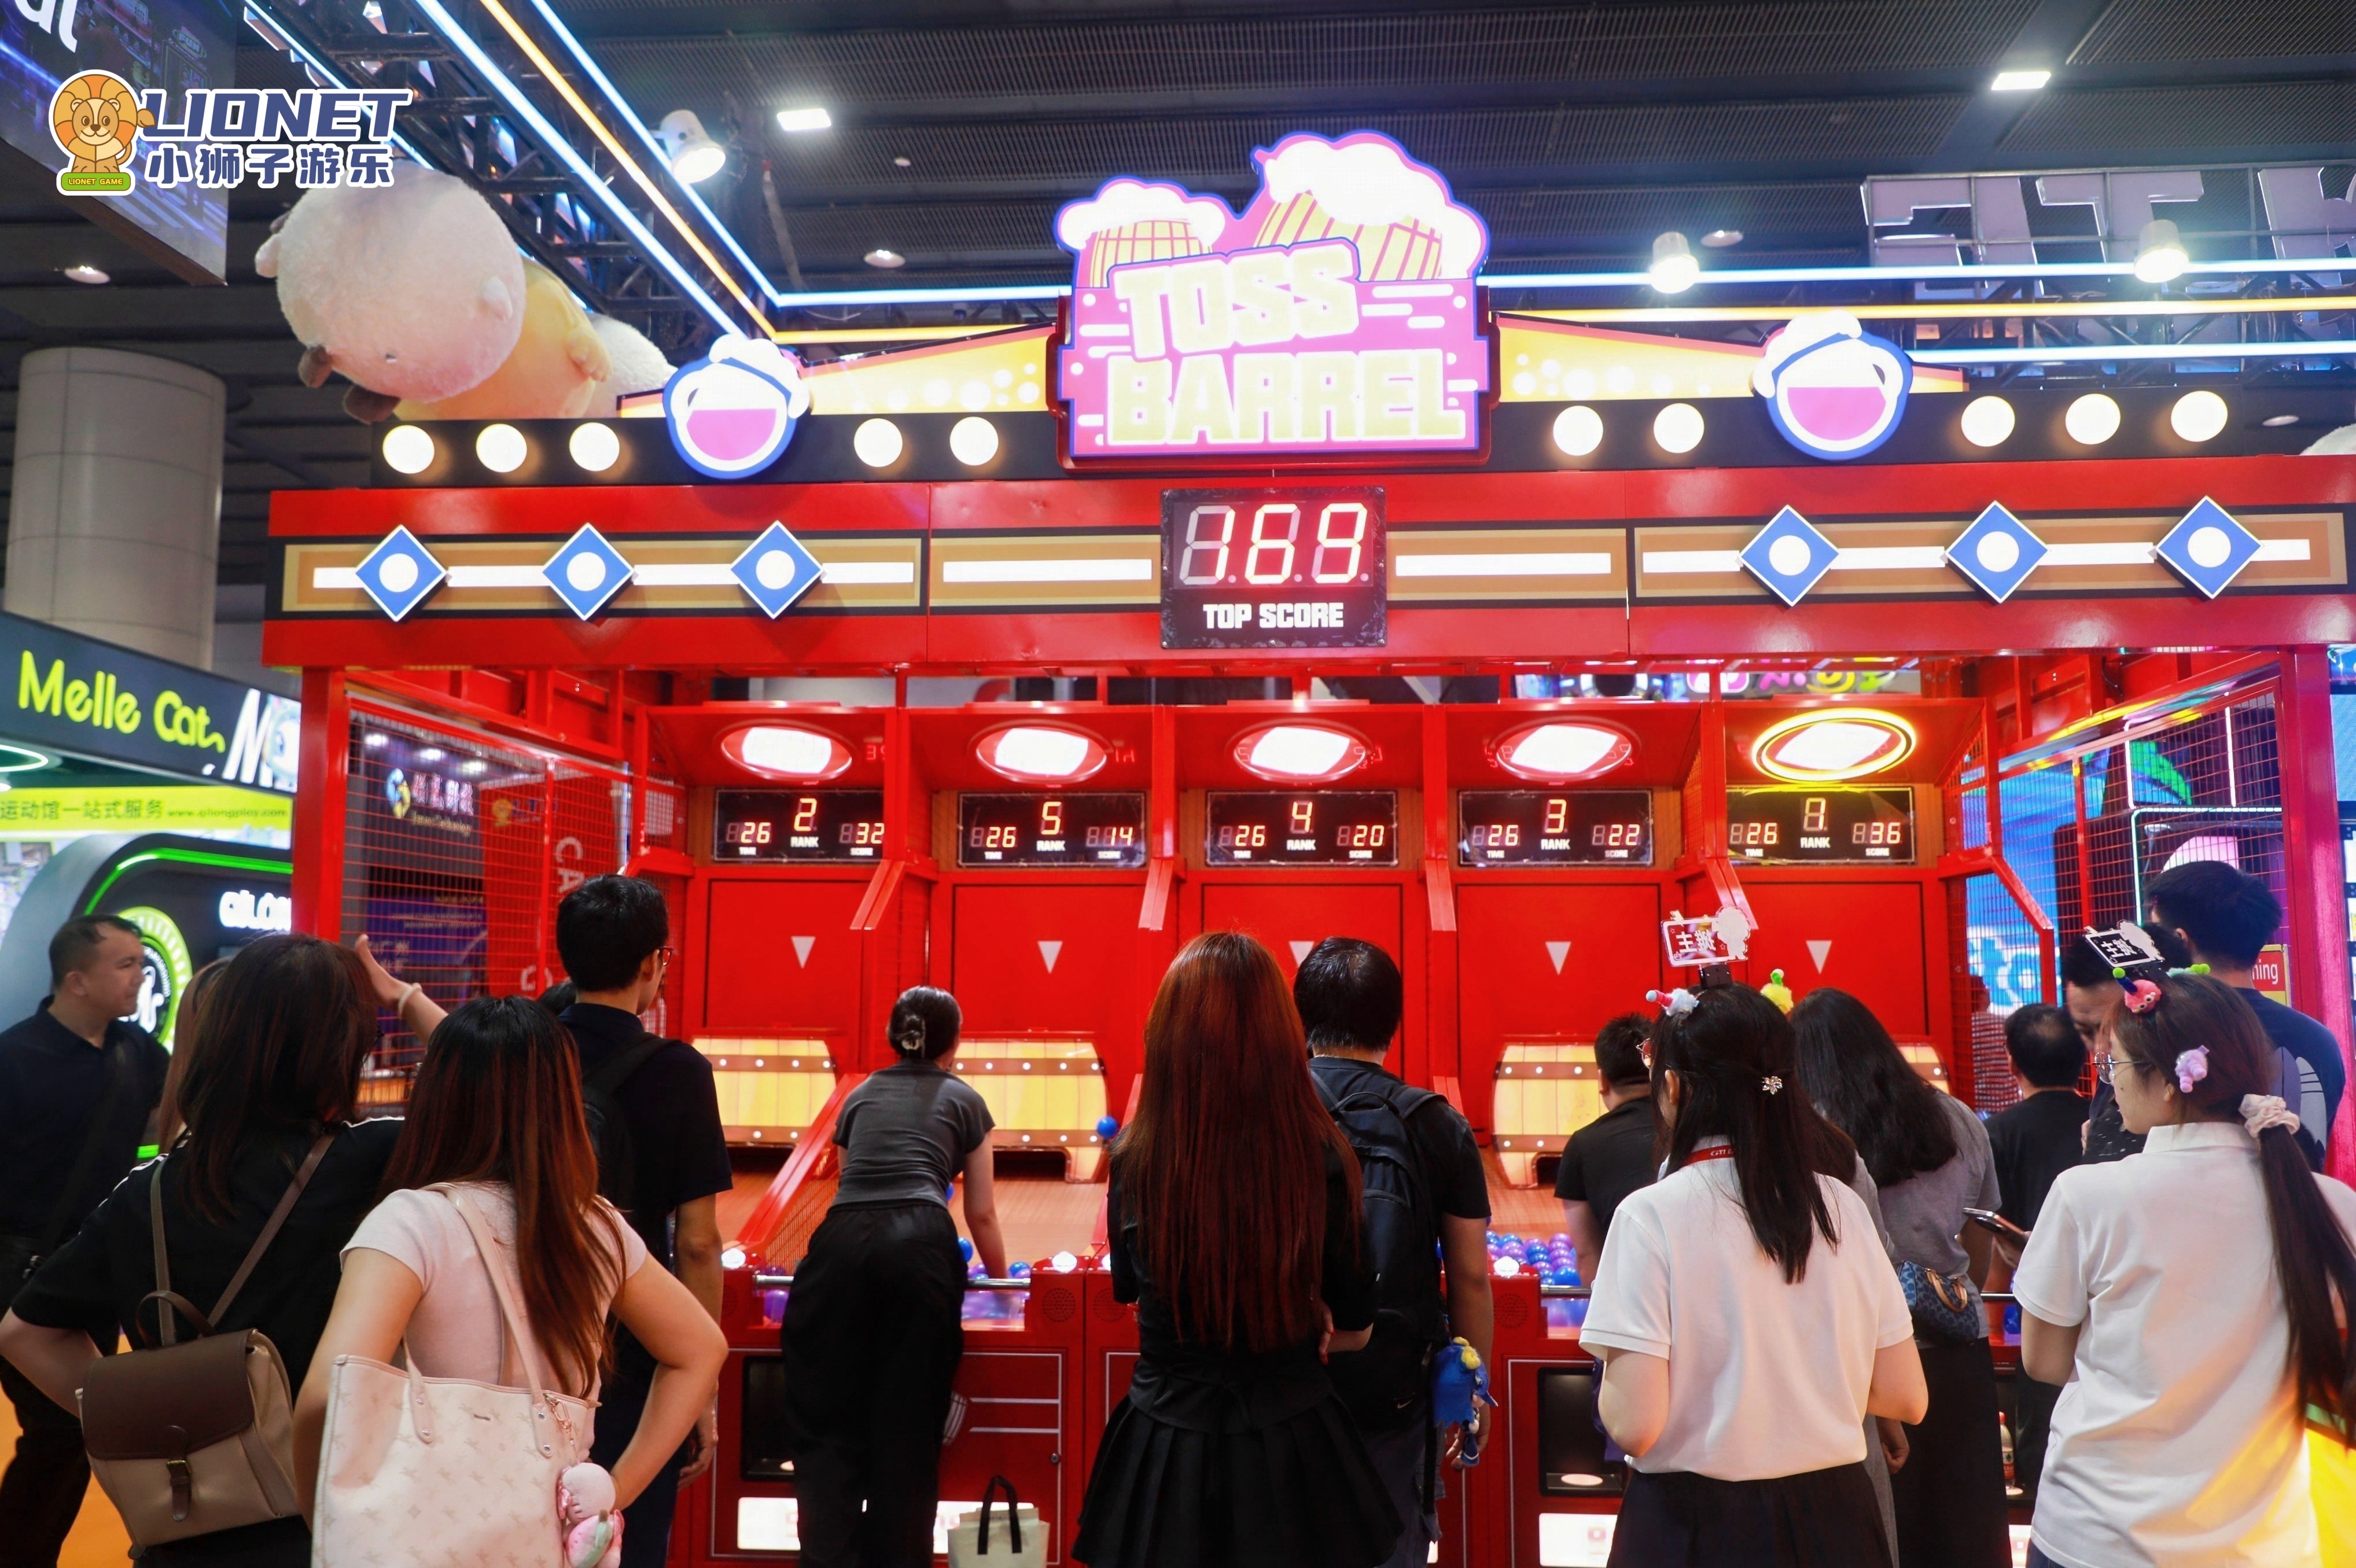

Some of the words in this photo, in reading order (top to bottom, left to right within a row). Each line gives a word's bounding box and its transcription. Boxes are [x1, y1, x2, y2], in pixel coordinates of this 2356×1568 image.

[1113, 242, 1360, 359] TOSS
[1107, 348, 1467, 446] BARREL
[1216, 502, 1368, 584] 169
[1203, 603, 1252, 629] TOP
[1259, 602, 1344, 628] SCORE
[19, 650, 142, 734] Melle
[153, 690, 226, 753] Cat
[0, 798, 164, 820] 运动馆一站式服务
[794, 798, 817, 831] 2
[1041, 801, 1062, 835] 5
[1292, 801, 1313, 833] 4
[1545, 799, 1567, 833] 3
[741, 822, 771, 843] 26
[790, 837, 819, 848] RANK
[855, 823, 885, 844] 32
[986, 827, 1017, 848] 26
[1110, 827, 1133, 846] 14
[1235, 826, 1265, 846] 26
[1353, 825, 1385, 846] 20
[1488, 825, 1519, 846] 26
[1608, 824, 1640, 846] 22
[1746, 822, 1777, 844] 26
[1800, 837, 1831, 848] RANK
[1870, 822, 1901, 844] 36
[1036, 840, 1066, 851] RANK
[1286, 839, 1316, 851] RANK
[1541, 838, 1570, 850] RANK
